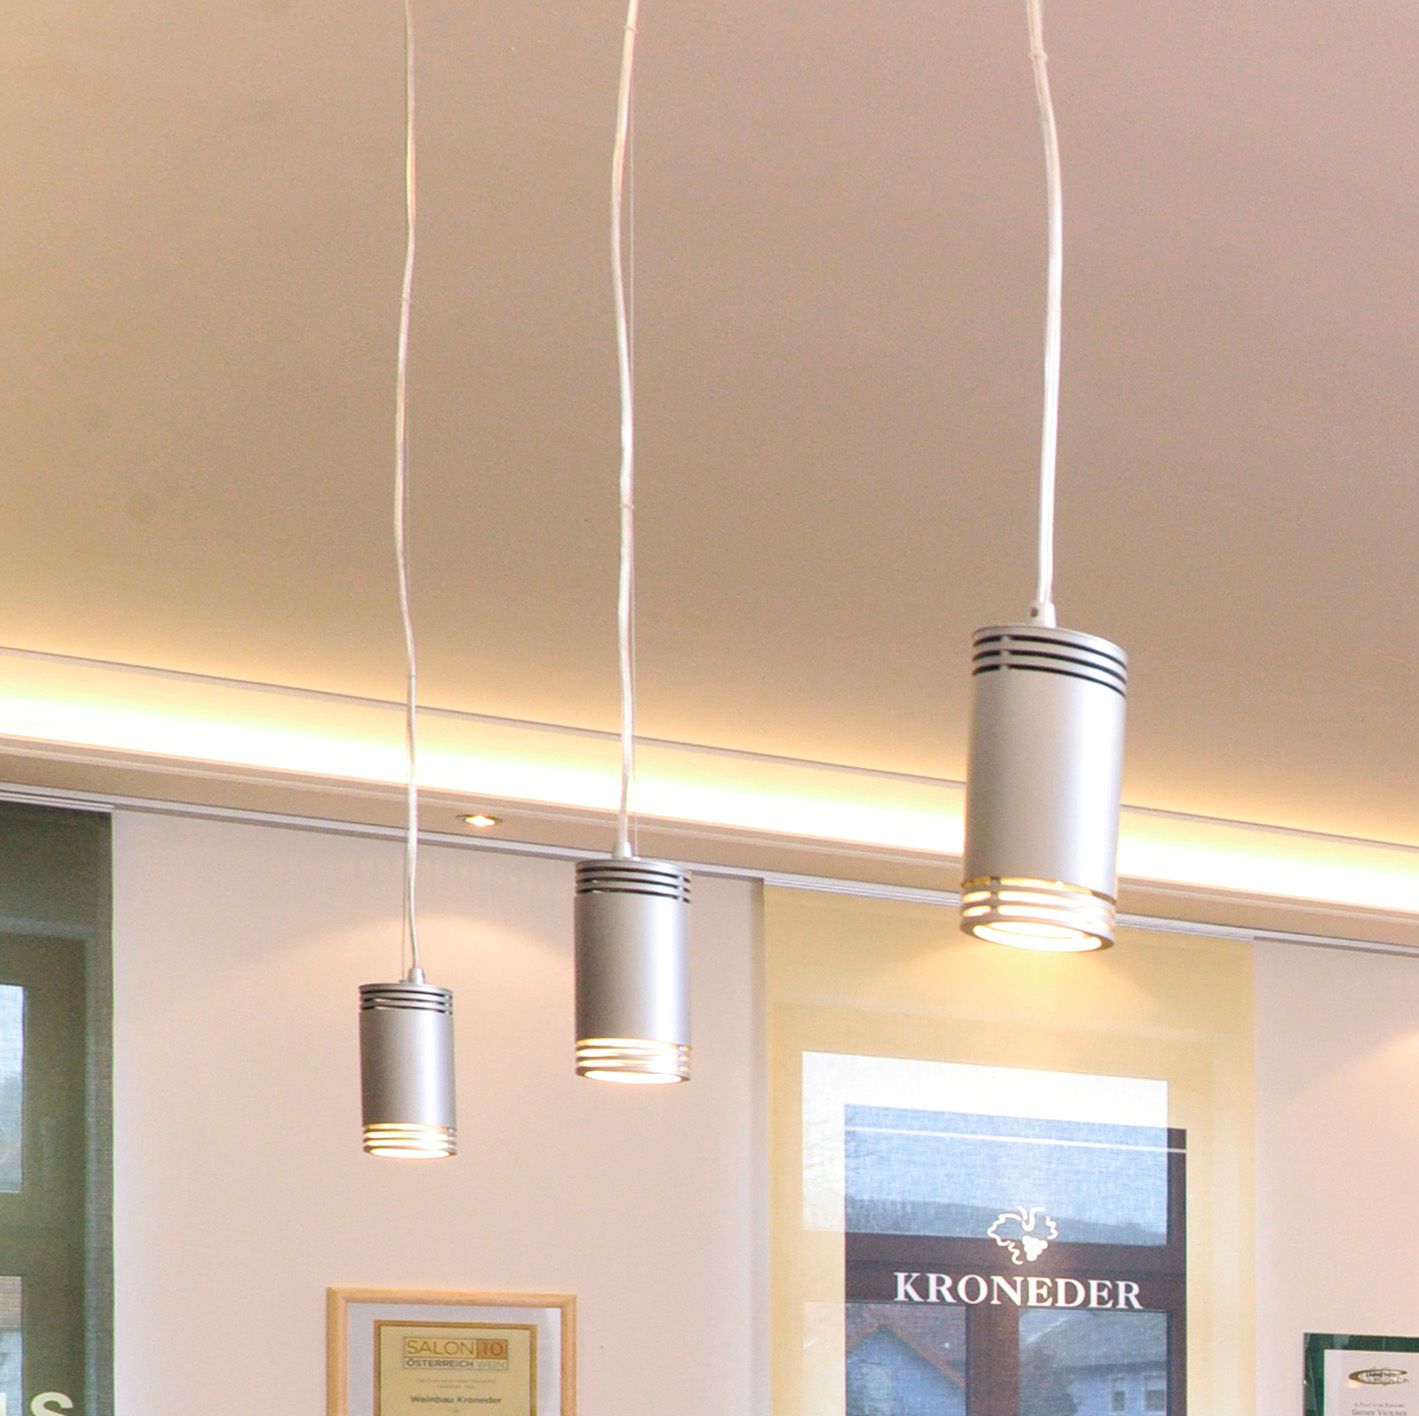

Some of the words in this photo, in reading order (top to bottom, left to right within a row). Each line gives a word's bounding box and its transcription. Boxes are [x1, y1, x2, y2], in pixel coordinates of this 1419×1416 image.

[893, 1271, 1144, 1310] KRONEDER
[405, 1339, 475, 1356] SALON
[480, 1341, 504, 1357] 10
[405, 1358, 474, 1368] ÖSTERREICH
[409, 1394, 455, 1404] Weinbau
